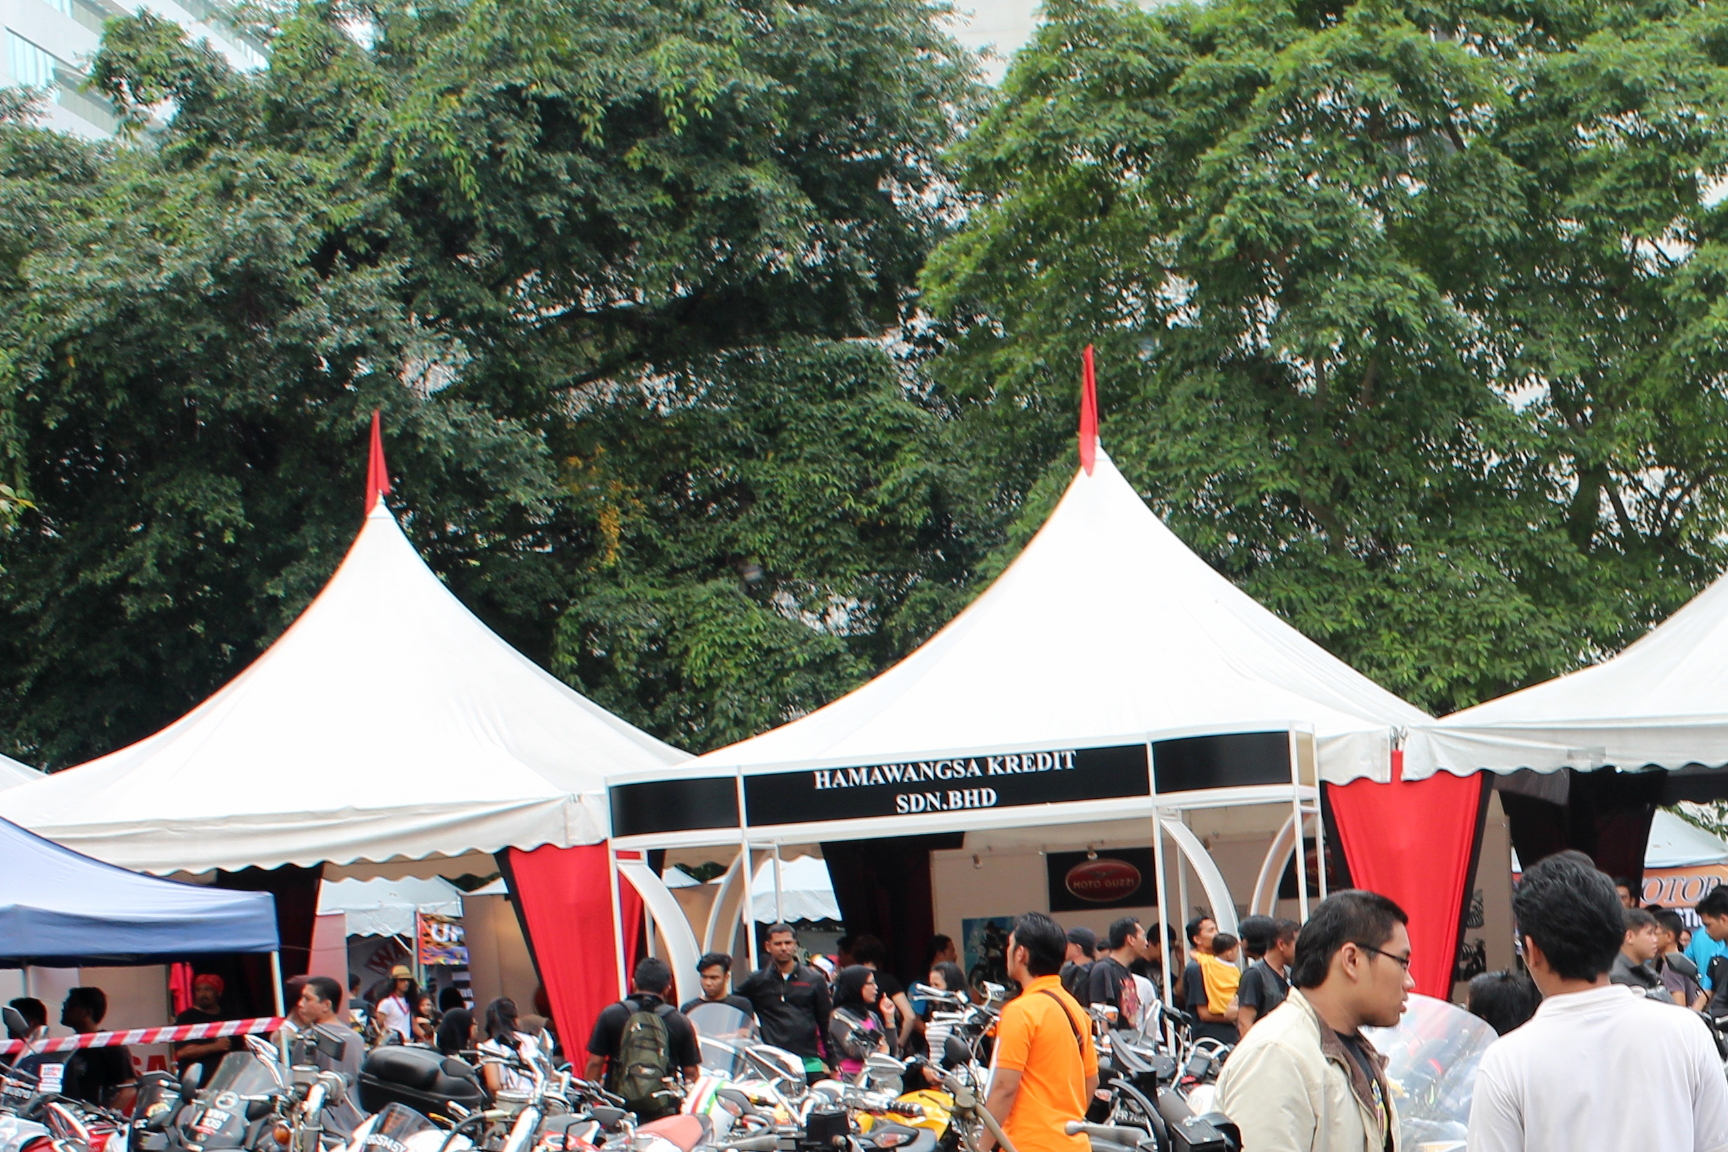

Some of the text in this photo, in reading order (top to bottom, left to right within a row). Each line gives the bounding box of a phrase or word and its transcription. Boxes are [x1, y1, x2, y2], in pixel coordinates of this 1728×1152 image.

[814, 751, 1077, 789] HAMAWANGSA KREDIT
[896, 787, 997, 814] SDN.BHD
[1073, 878, 1135, 889] MOTO GUZZI
